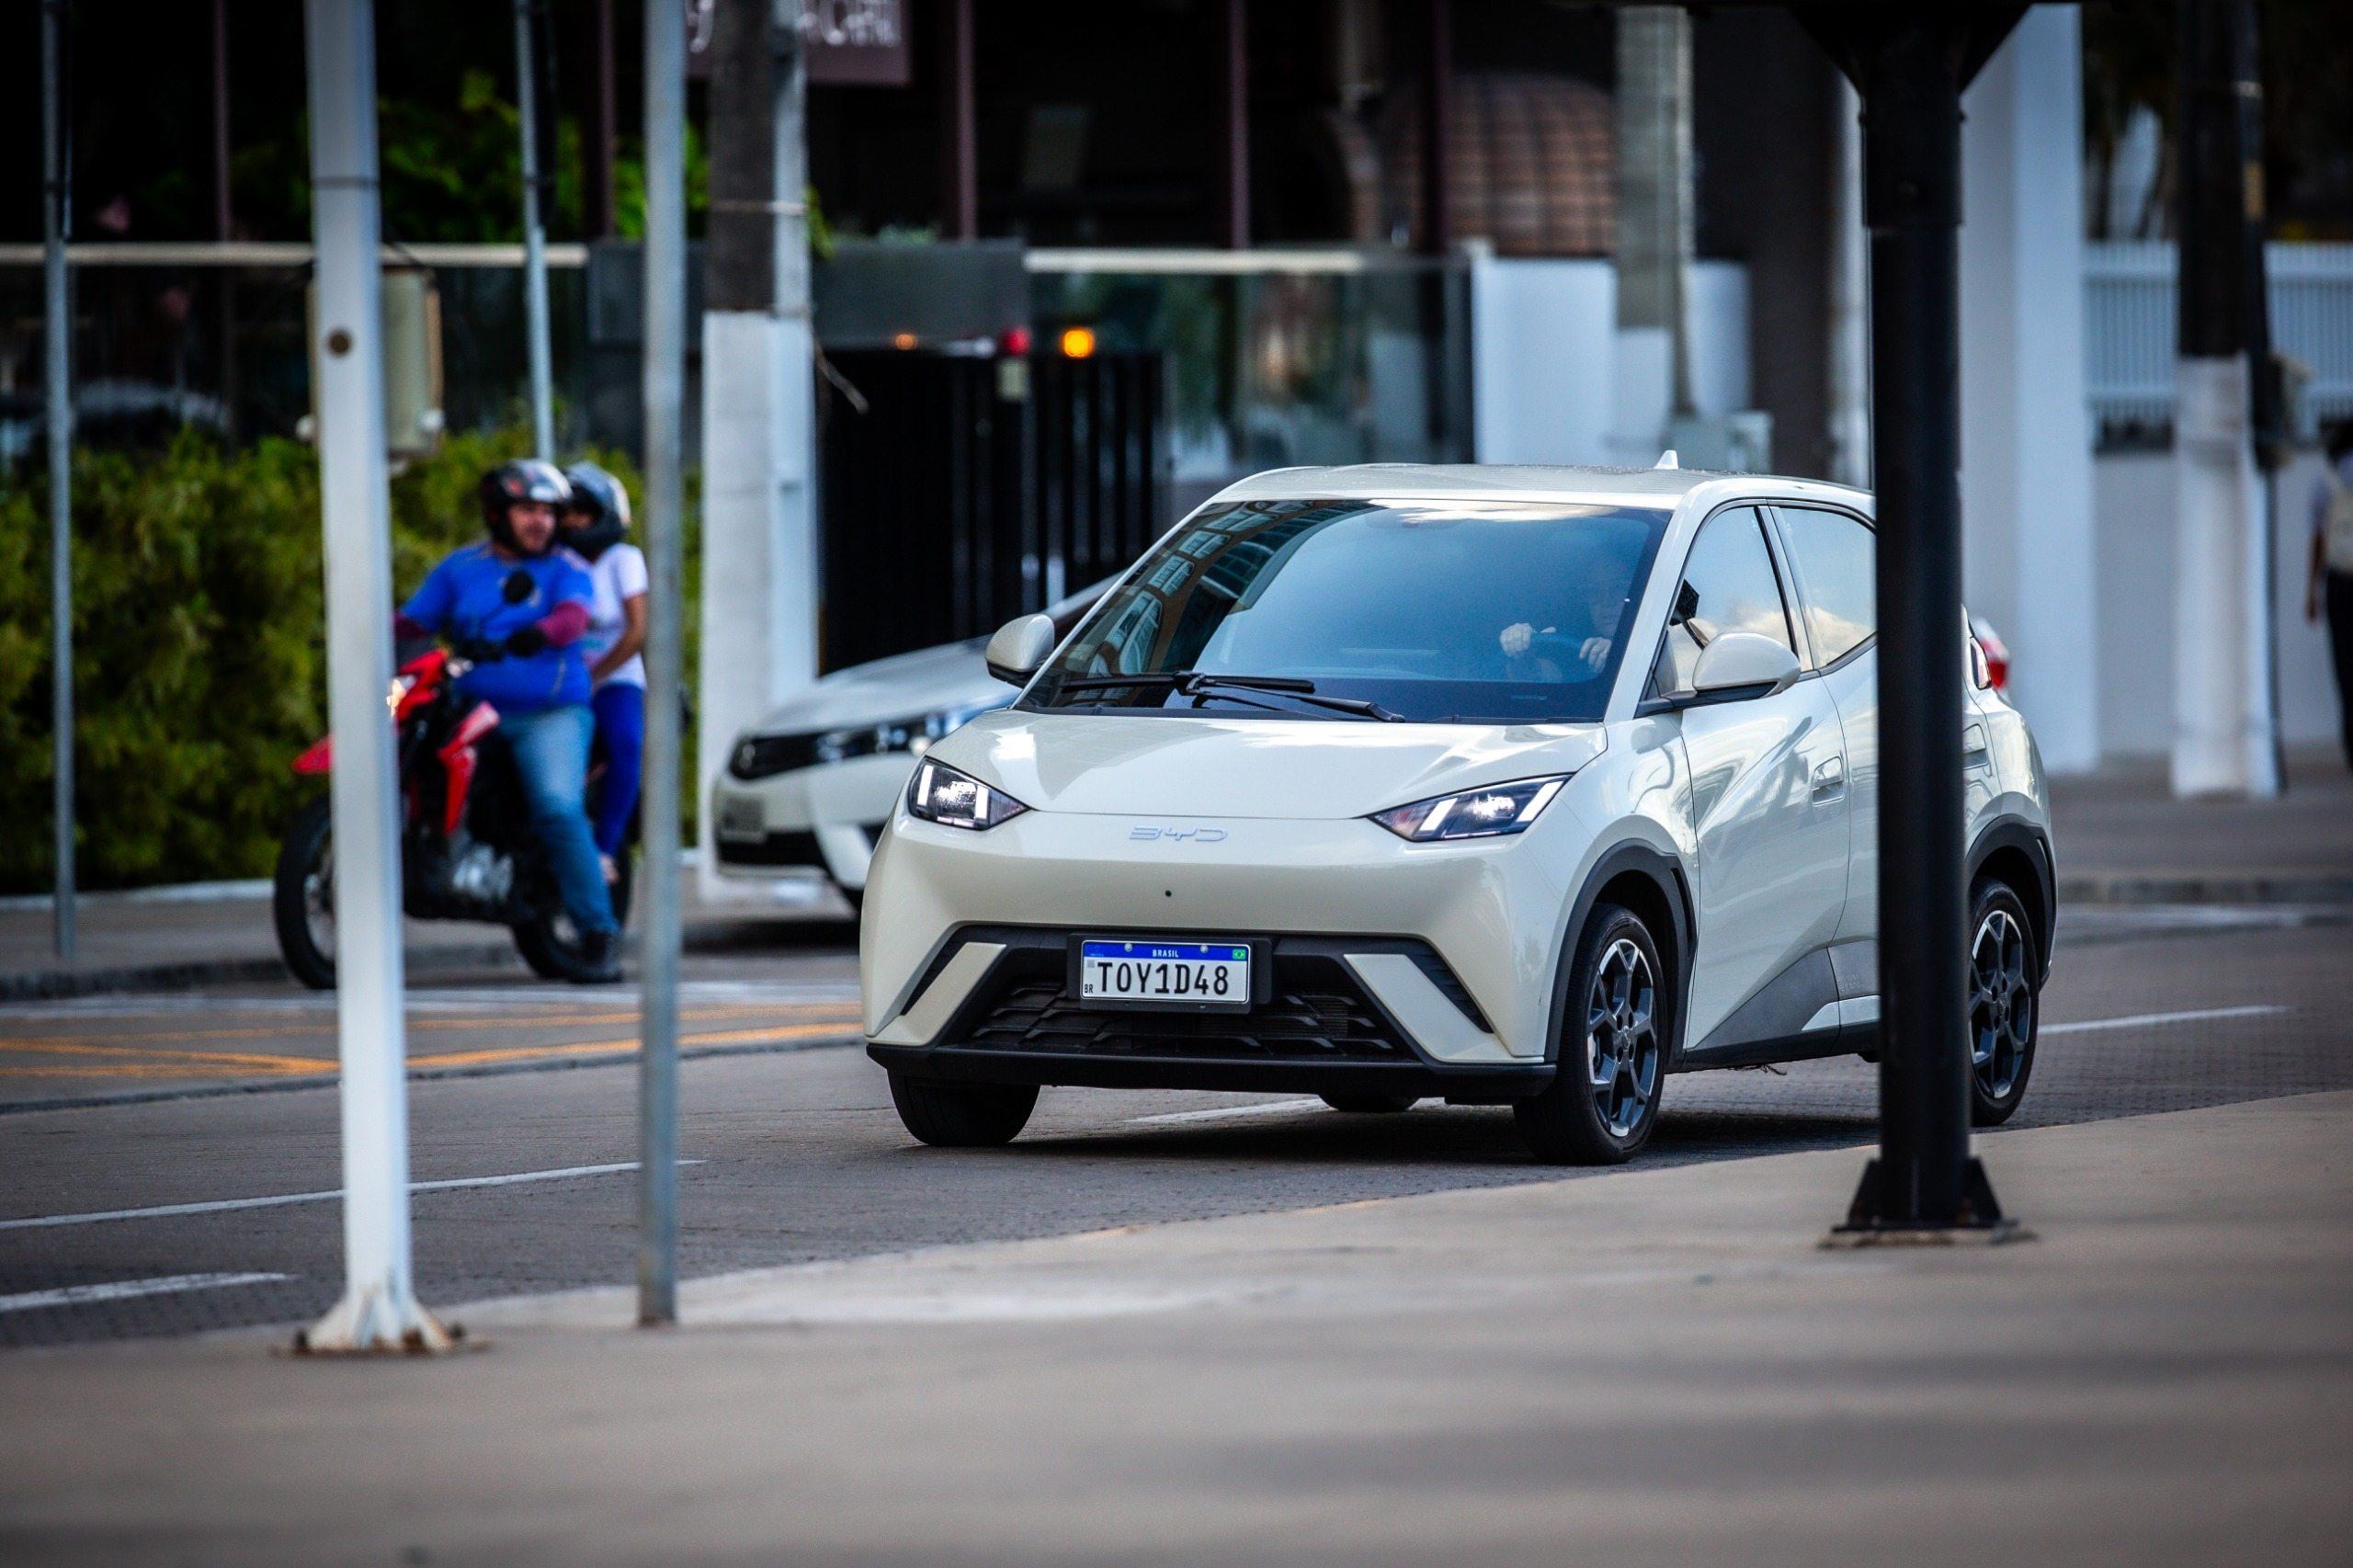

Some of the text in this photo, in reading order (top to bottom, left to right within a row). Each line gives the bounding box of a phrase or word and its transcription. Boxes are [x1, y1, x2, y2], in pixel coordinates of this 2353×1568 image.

[1130, 825, 1228, 842] BYD
[1152, 949, 1179, 958] BRASIL
[1097, 961, 1228, 995] TOY1D48
[1084, 983, 1094, 994] BR
